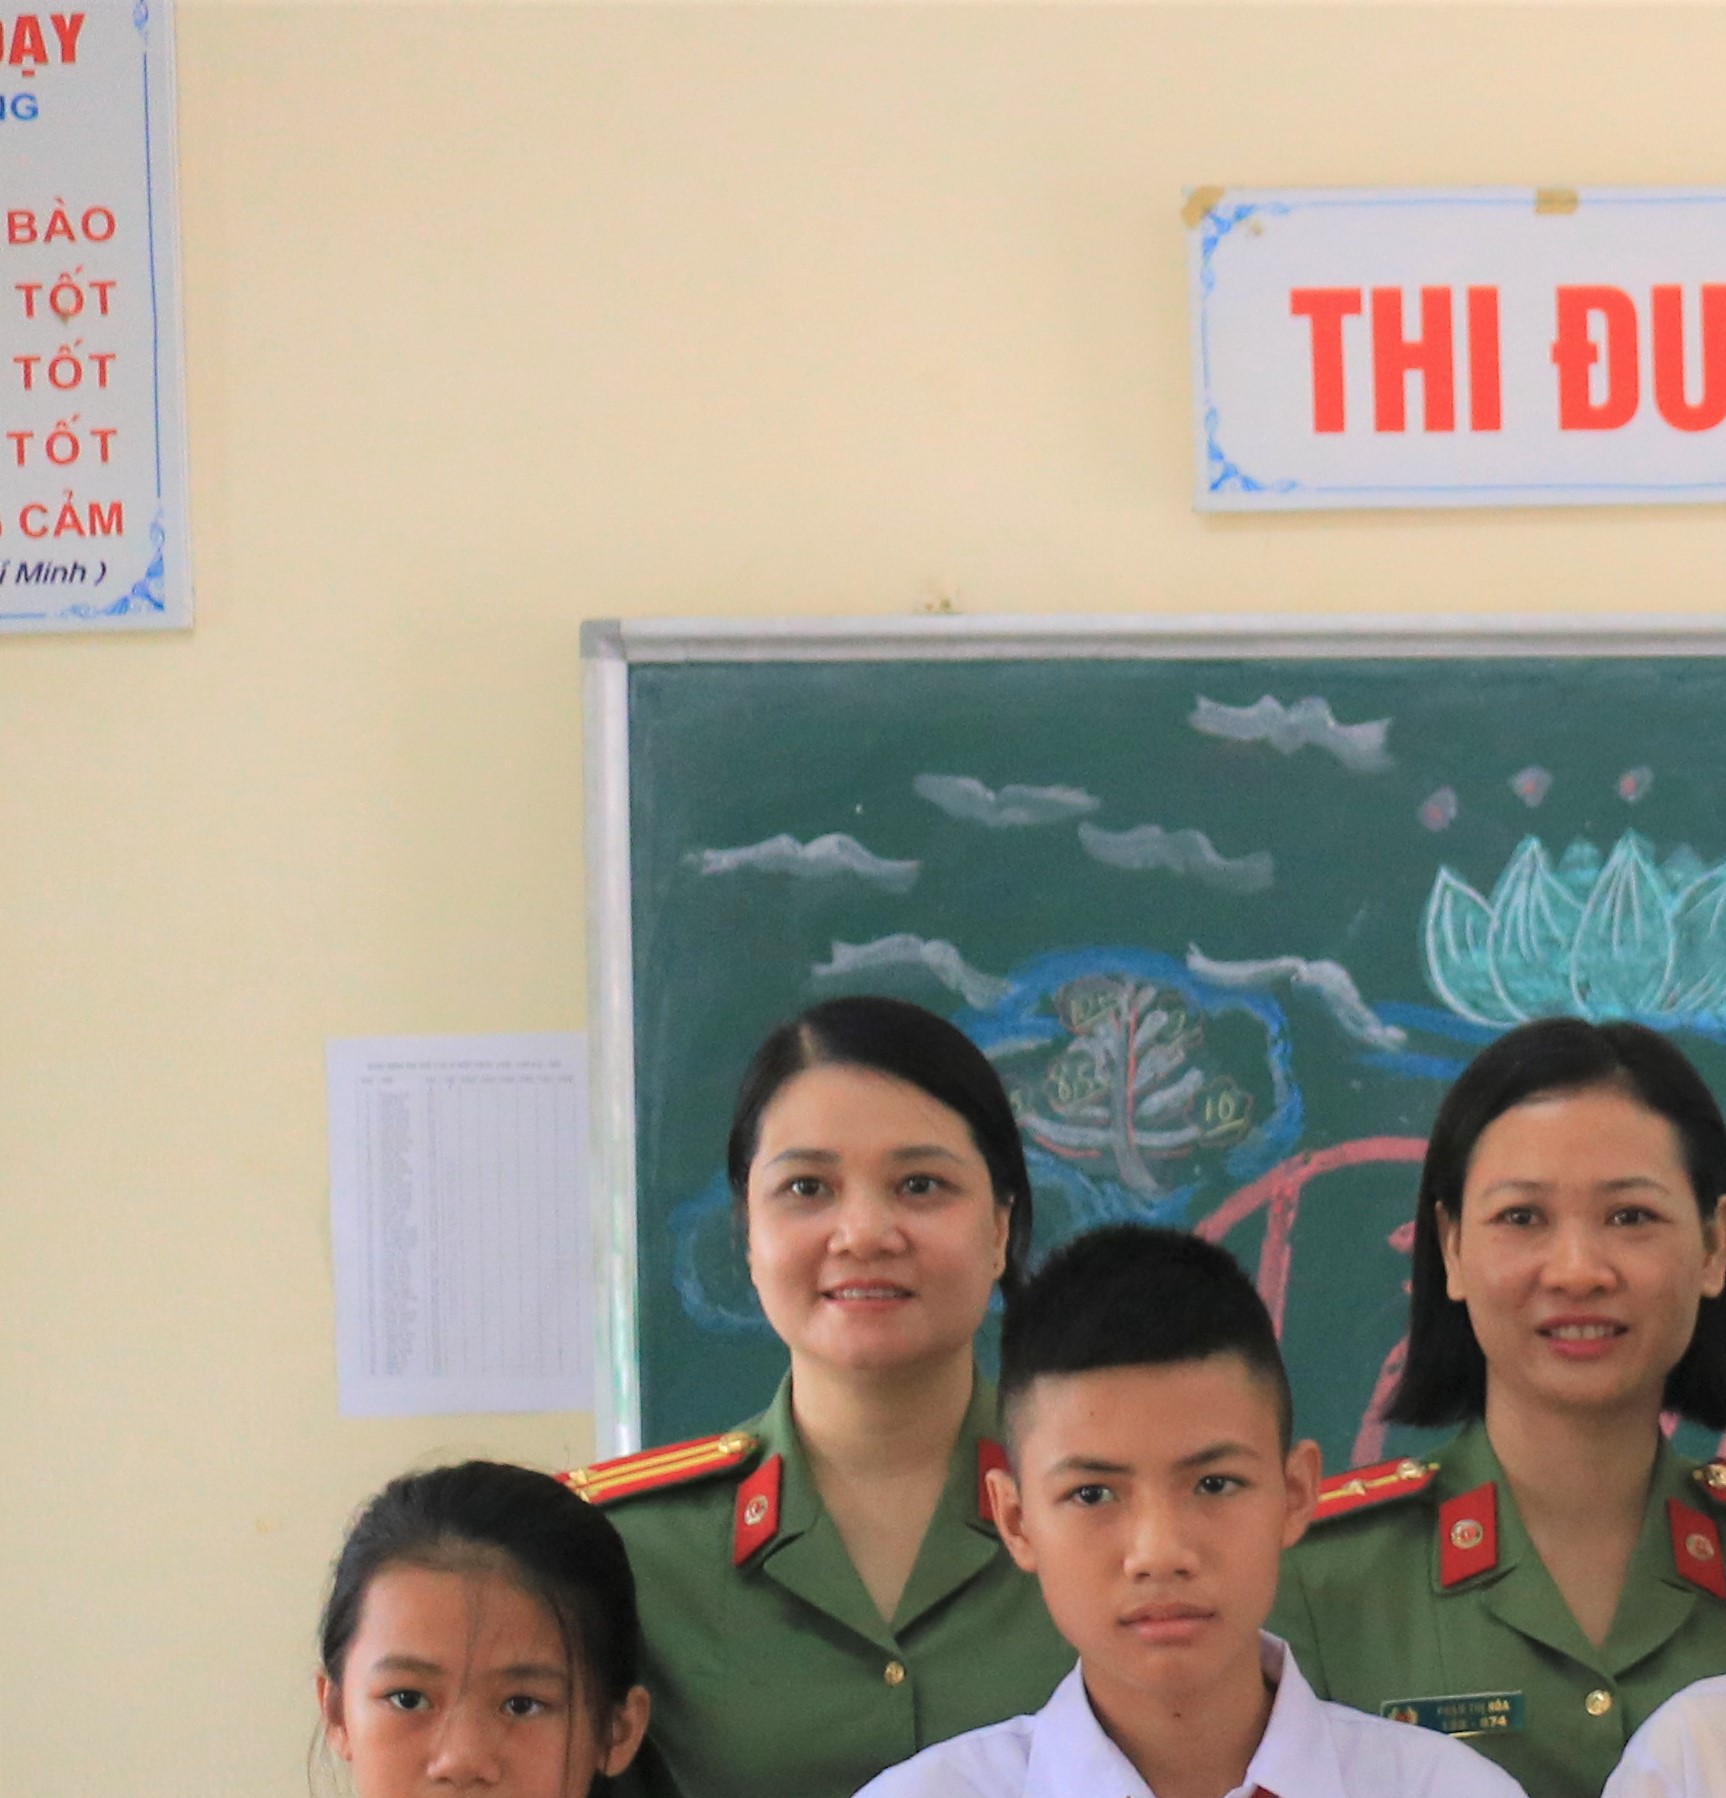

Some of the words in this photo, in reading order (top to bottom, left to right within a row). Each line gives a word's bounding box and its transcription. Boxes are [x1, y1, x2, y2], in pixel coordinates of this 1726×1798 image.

[0, 12, 86, 78] ẠY
[6, 196, 117, 245] BÀO
[14, 264, 117, 321] TỐT
[12, 338, 117, 391] TỐT
[1290, 285, 1503, 434] THI
[6, 414, 118, 467] TỐT
[18, 488, 124, 539] CẢM
[15, 560, 87, 585] Minh
